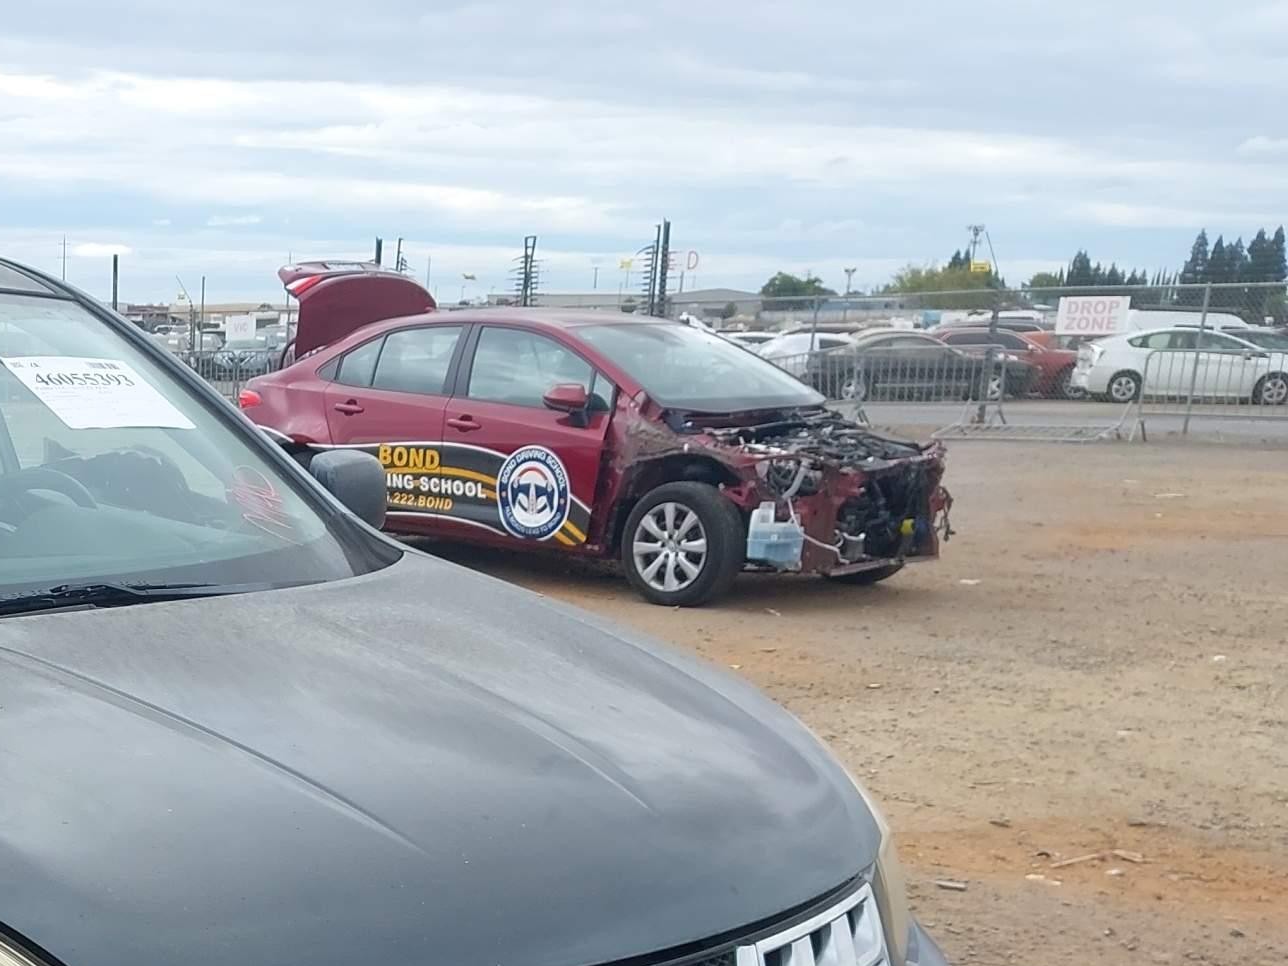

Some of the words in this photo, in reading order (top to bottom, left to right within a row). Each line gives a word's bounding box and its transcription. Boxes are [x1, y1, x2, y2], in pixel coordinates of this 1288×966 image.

[1066, 300, 1120, 315] DROP
[1064, 317, 1118, 330] ZONE
[35, 372, 135, 387] 46055393
[379, 443, 440, 470] BOND
[515, 450, 546, 462] DRIVING
[546, 455, 566, 491] SCHOOL
[419, 475, 487, 499] SCHOOL
